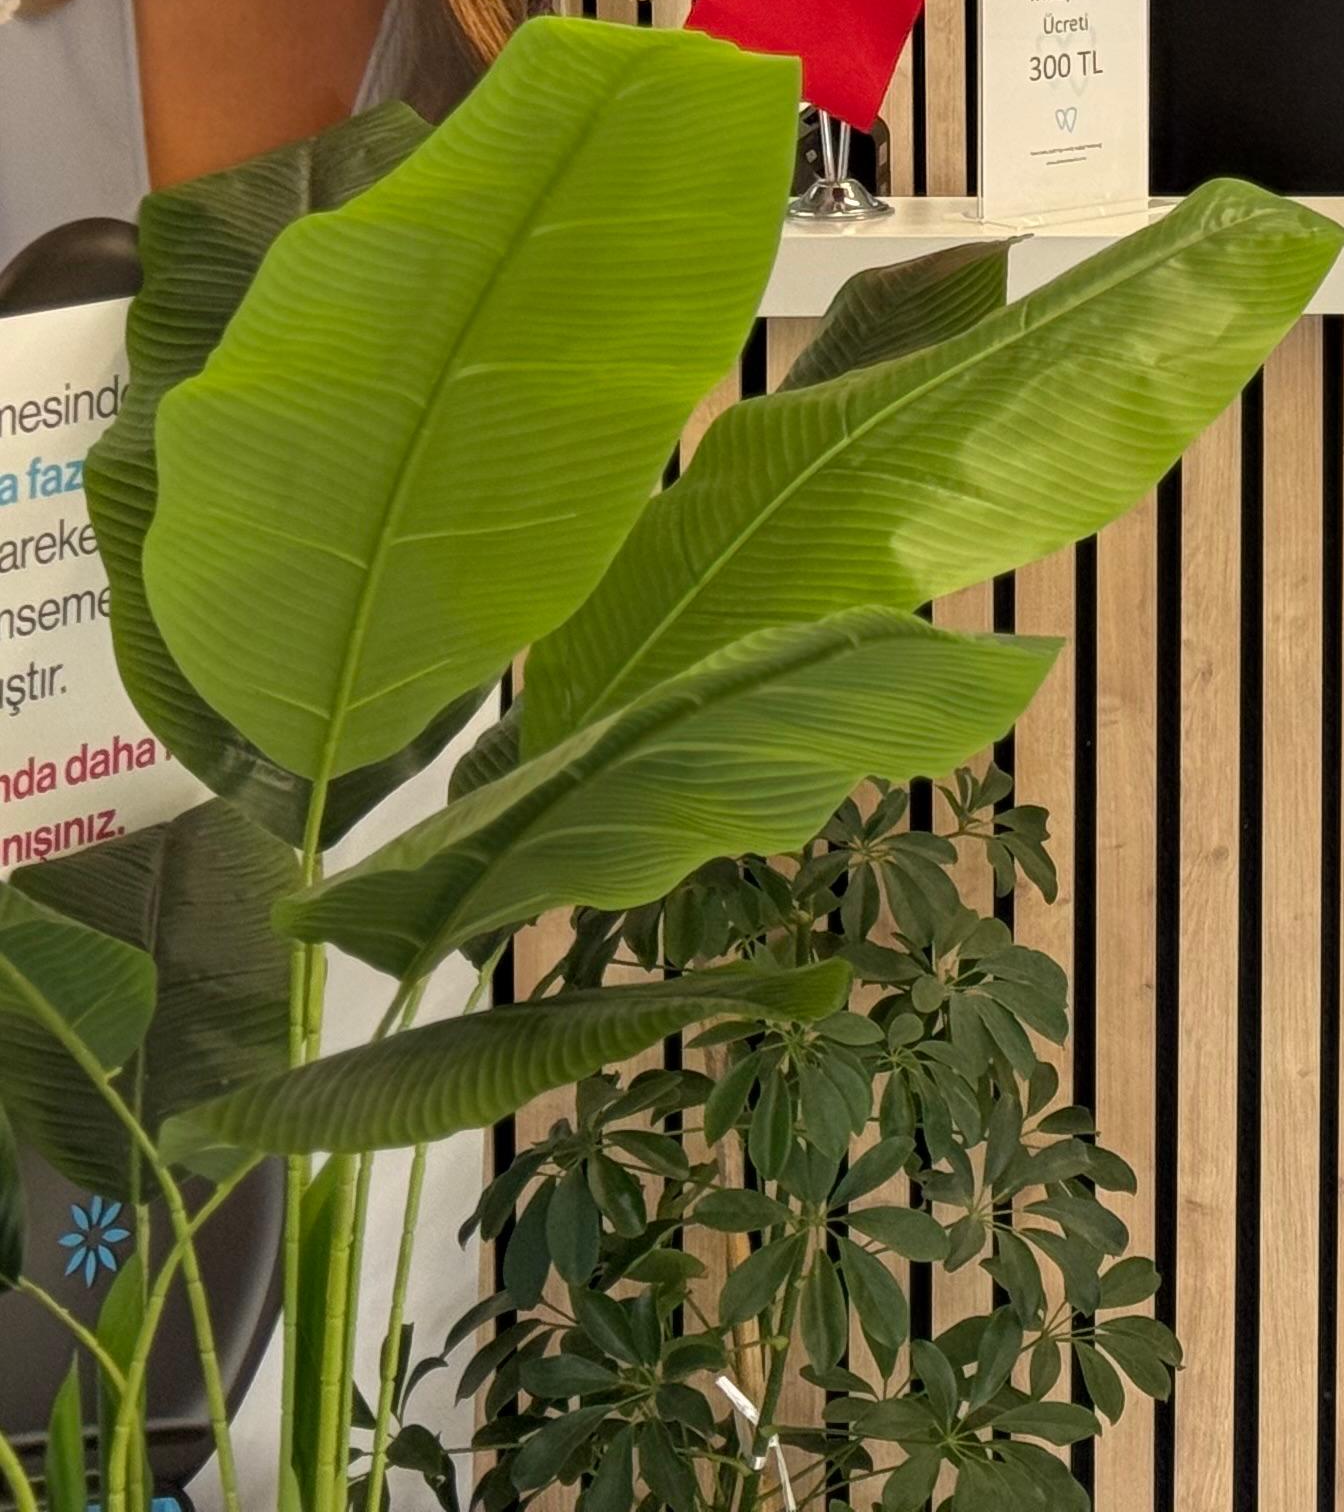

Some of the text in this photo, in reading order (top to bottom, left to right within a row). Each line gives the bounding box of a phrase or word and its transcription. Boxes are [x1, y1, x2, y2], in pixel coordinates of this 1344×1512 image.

[1043, 13, 1089, 34] Ücreti
[1029, 50, 1103, 82] 300 TL
[65, 735, 156, 786] daha
